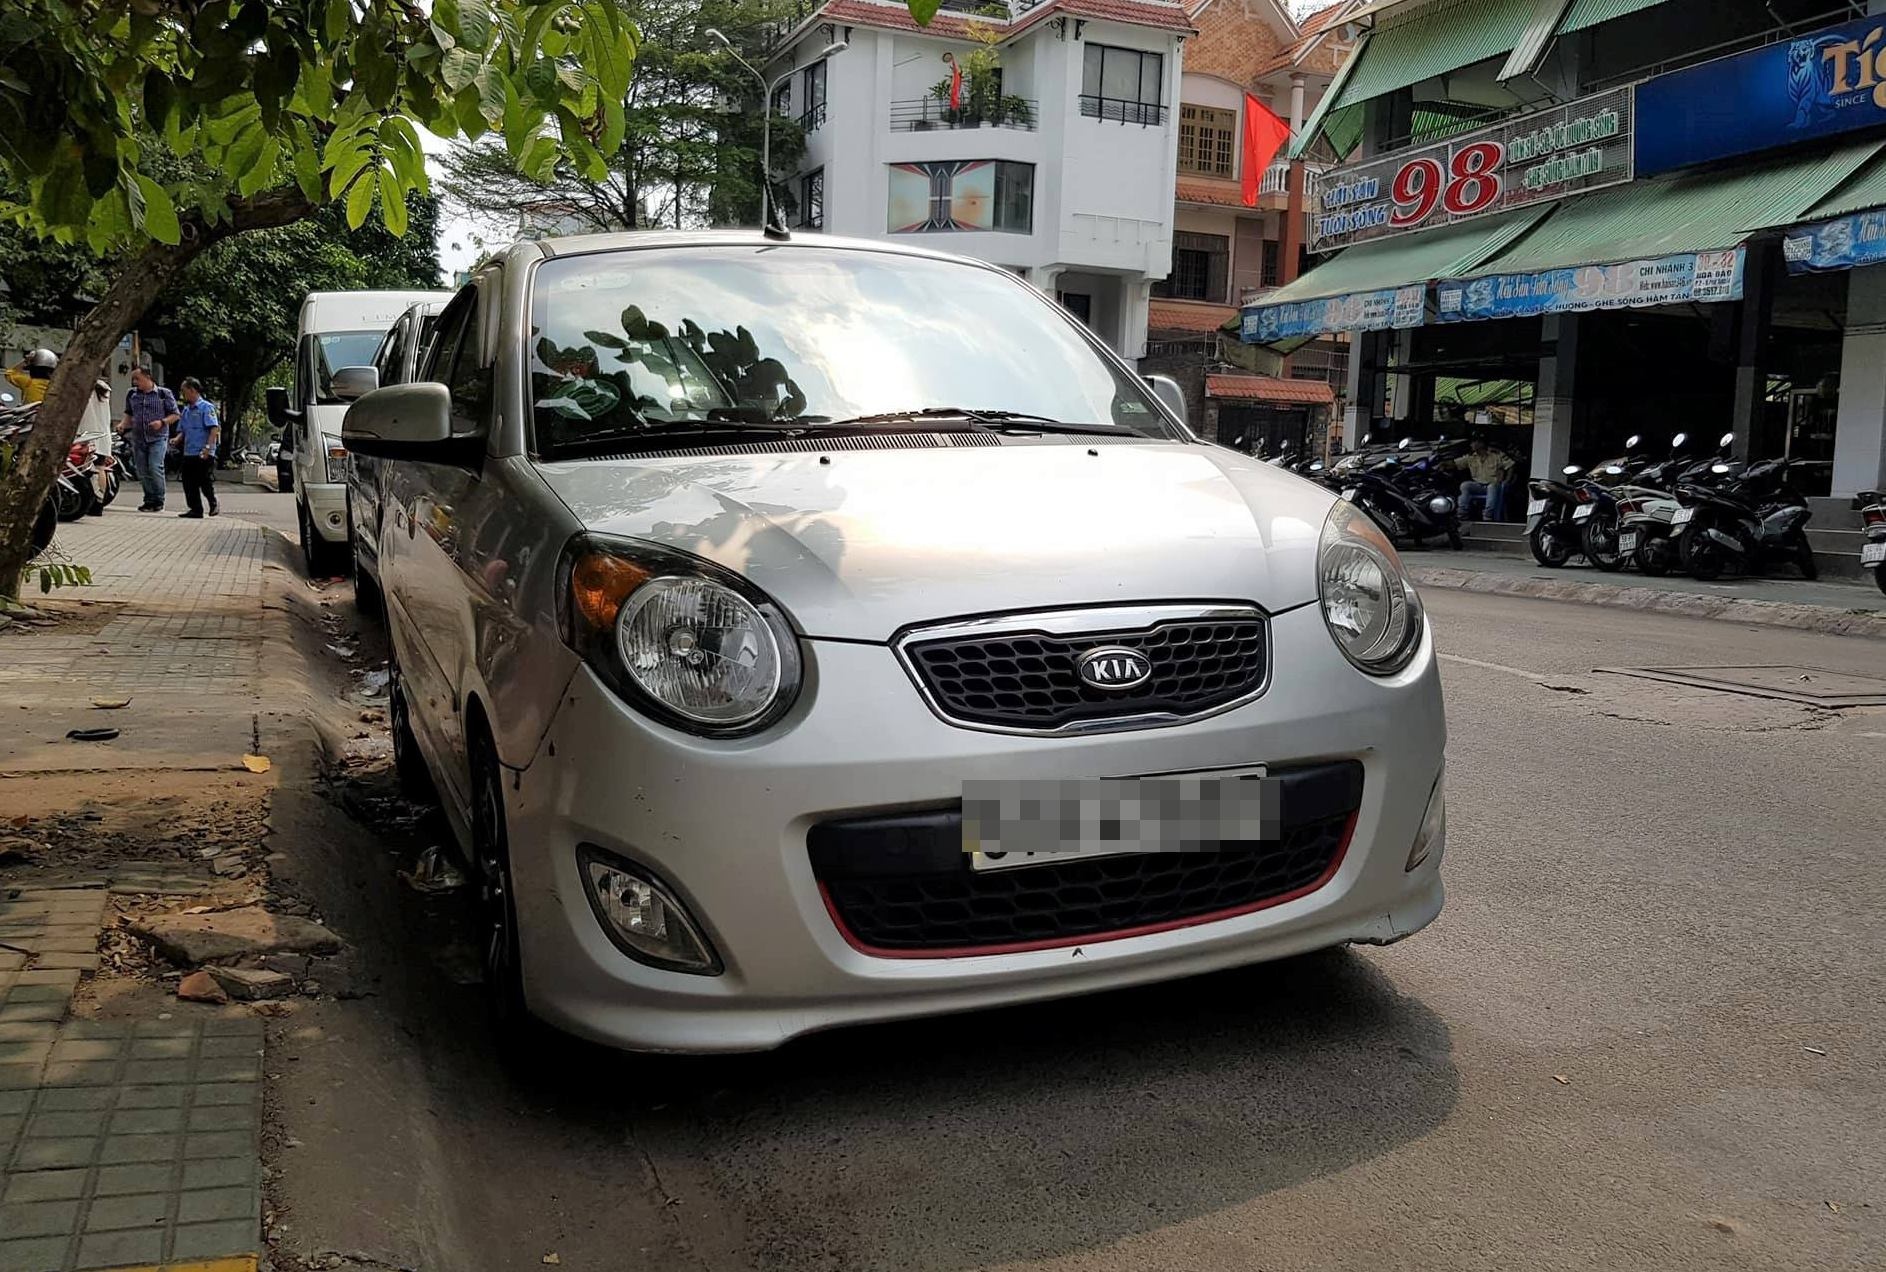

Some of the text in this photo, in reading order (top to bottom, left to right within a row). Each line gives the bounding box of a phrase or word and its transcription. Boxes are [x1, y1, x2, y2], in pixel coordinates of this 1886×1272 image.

[1835, 94, 1867, 109] SINCE
[1389, 141, 1505, 227] 98
[1640, 266, 1653, 276] CHI
[1688, 262, 1693, 271] 3
[1091, 658, 1142, 681] KIA
